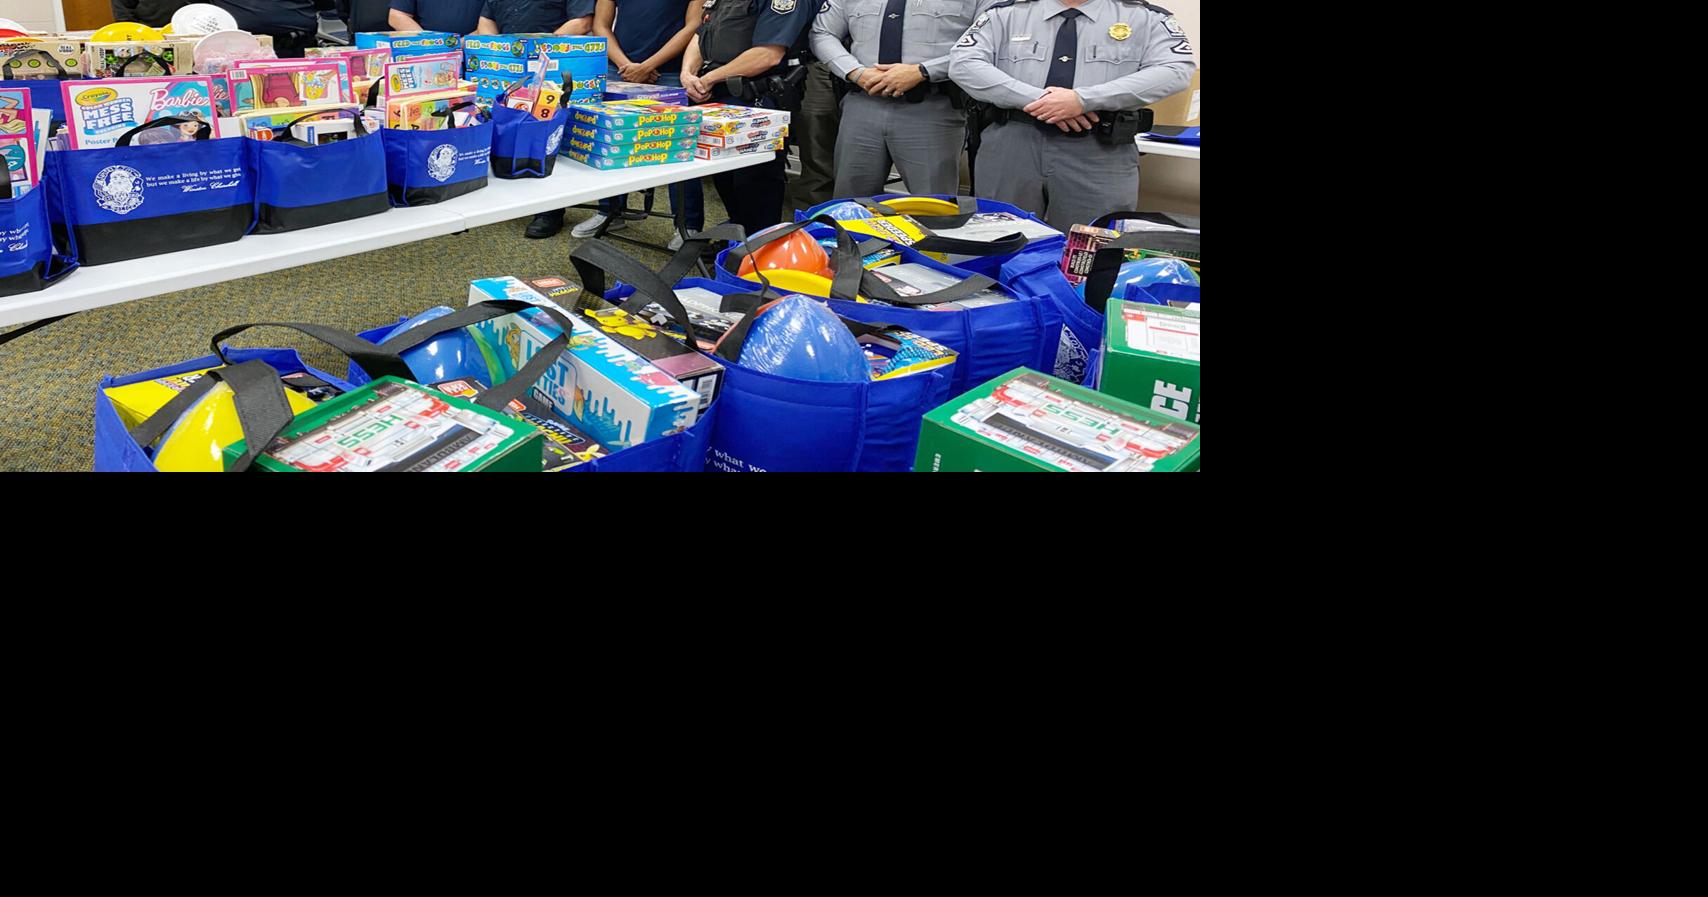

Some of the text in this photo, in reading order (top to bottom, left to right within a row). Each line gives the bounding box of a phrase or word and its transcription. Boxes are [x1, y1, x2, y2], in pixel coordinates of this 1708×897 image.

[149, 88, 210, 110] Barbie
[546, 94, 555, 105] 9
[83, 102, 132, 121] MESS
[85, 112, 133, 130] FREE
[541, 108, 550, 118] 8
[1042, 403, 1121, 436] HESS
[336, 414, 404, 449] HESS
[714, 449, 744, 469] what
